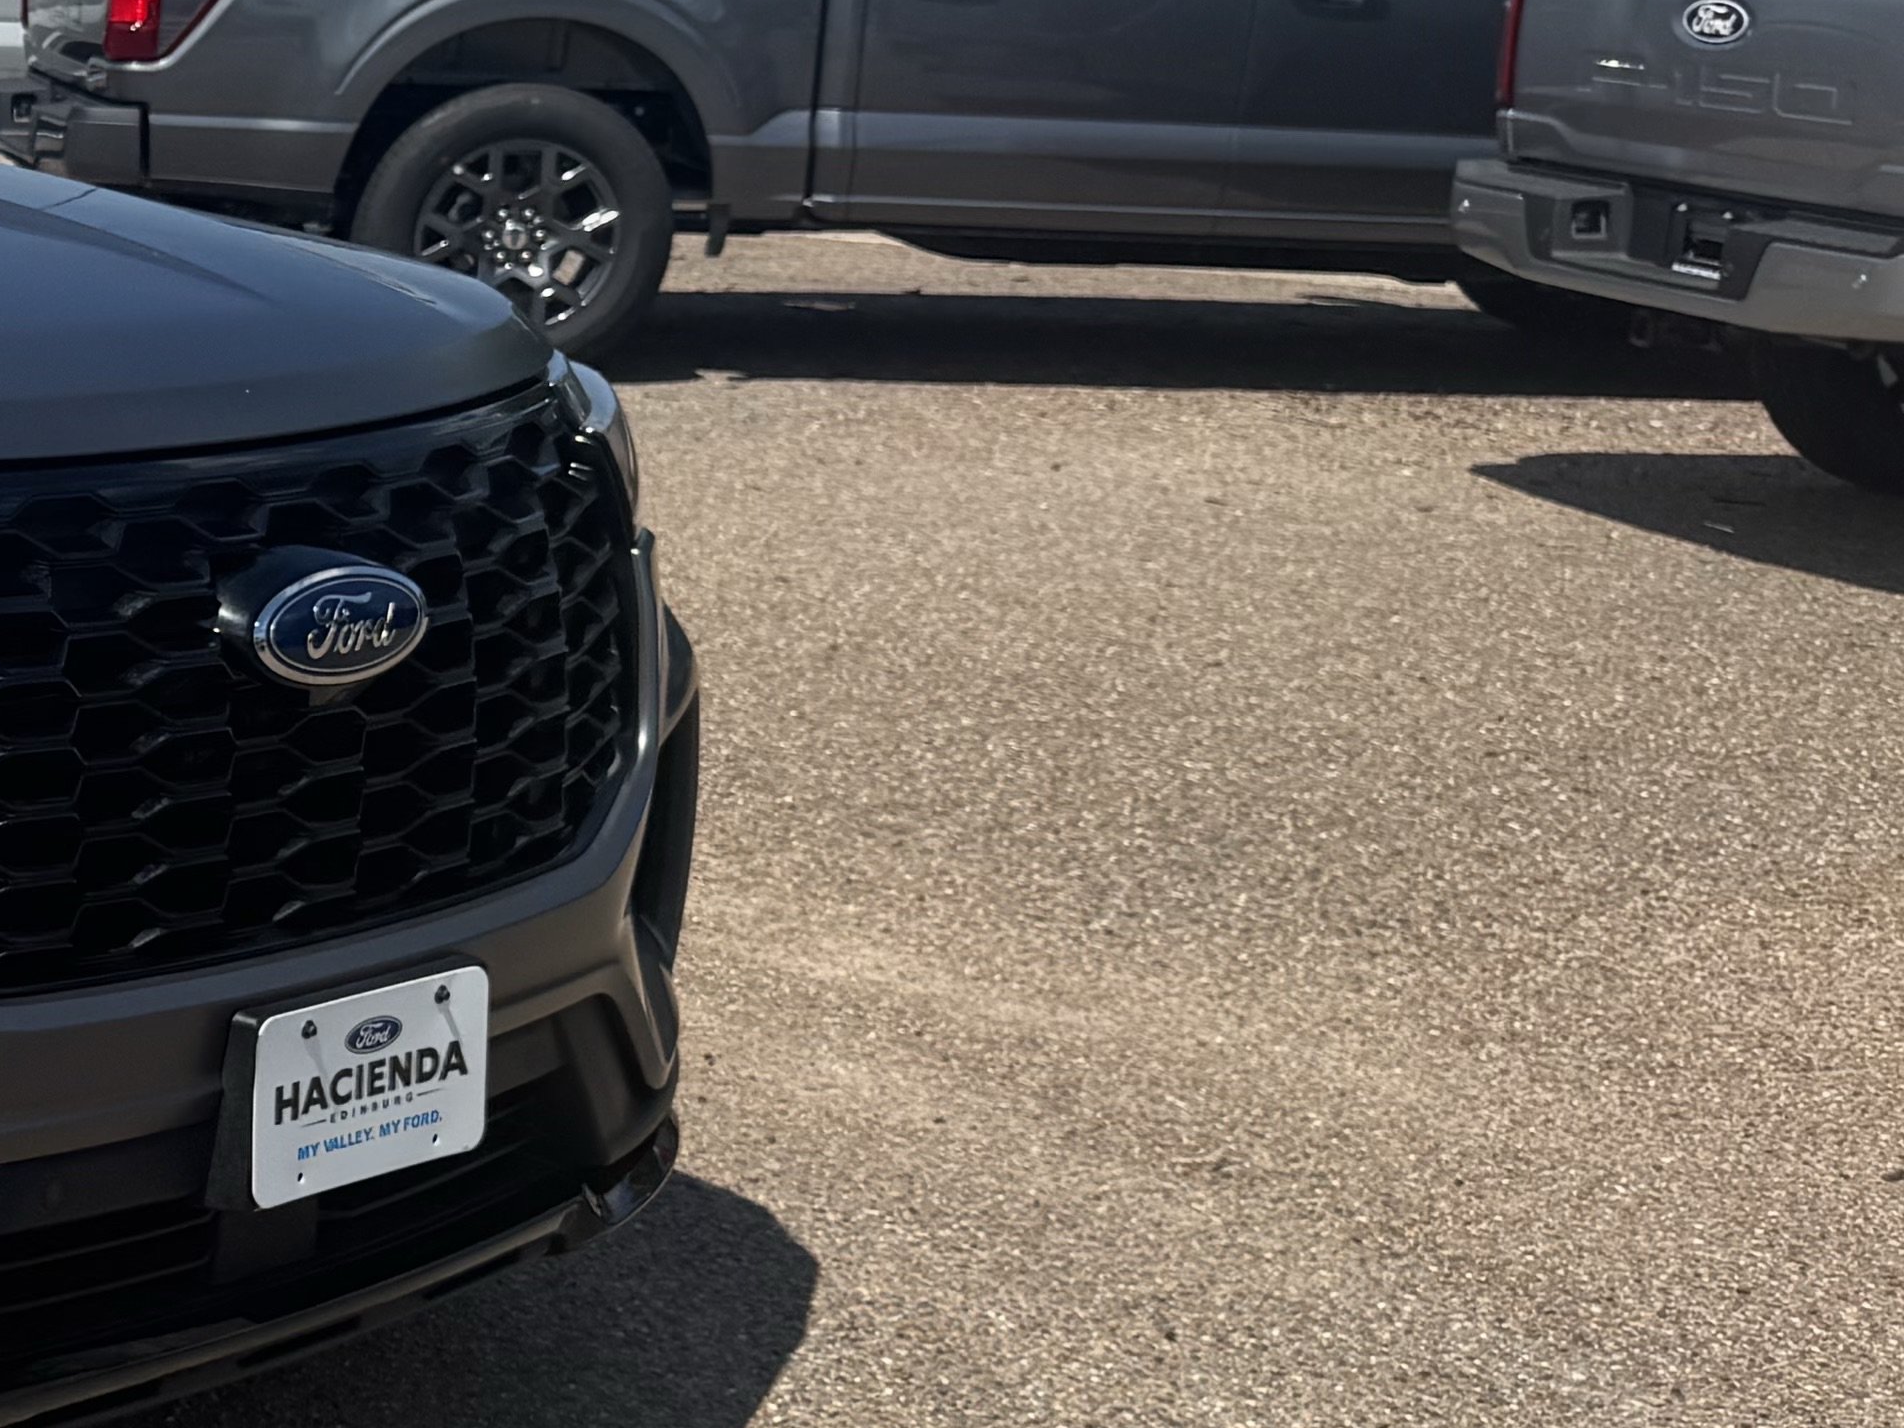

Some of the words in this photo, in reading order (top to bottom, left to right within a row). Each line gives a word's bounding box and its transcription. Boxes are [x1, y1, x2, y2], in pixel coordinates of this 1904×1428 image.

[1692, 4, 1738, 36] Ford
[307, 592, 396, 659] Ford
[355, 1022, 391, 1049] Ford
[274, 1040, 469, 1125] HACIENDA
[329, 1091, 414, 1124] EDINBURG
[297, 1142, 320, 1161] MY
[323, 1127, 375, 1153] VALLEY.
[379, 1118, 403, 1138] MY
[402, 1109, 443, 1132] FORD.
